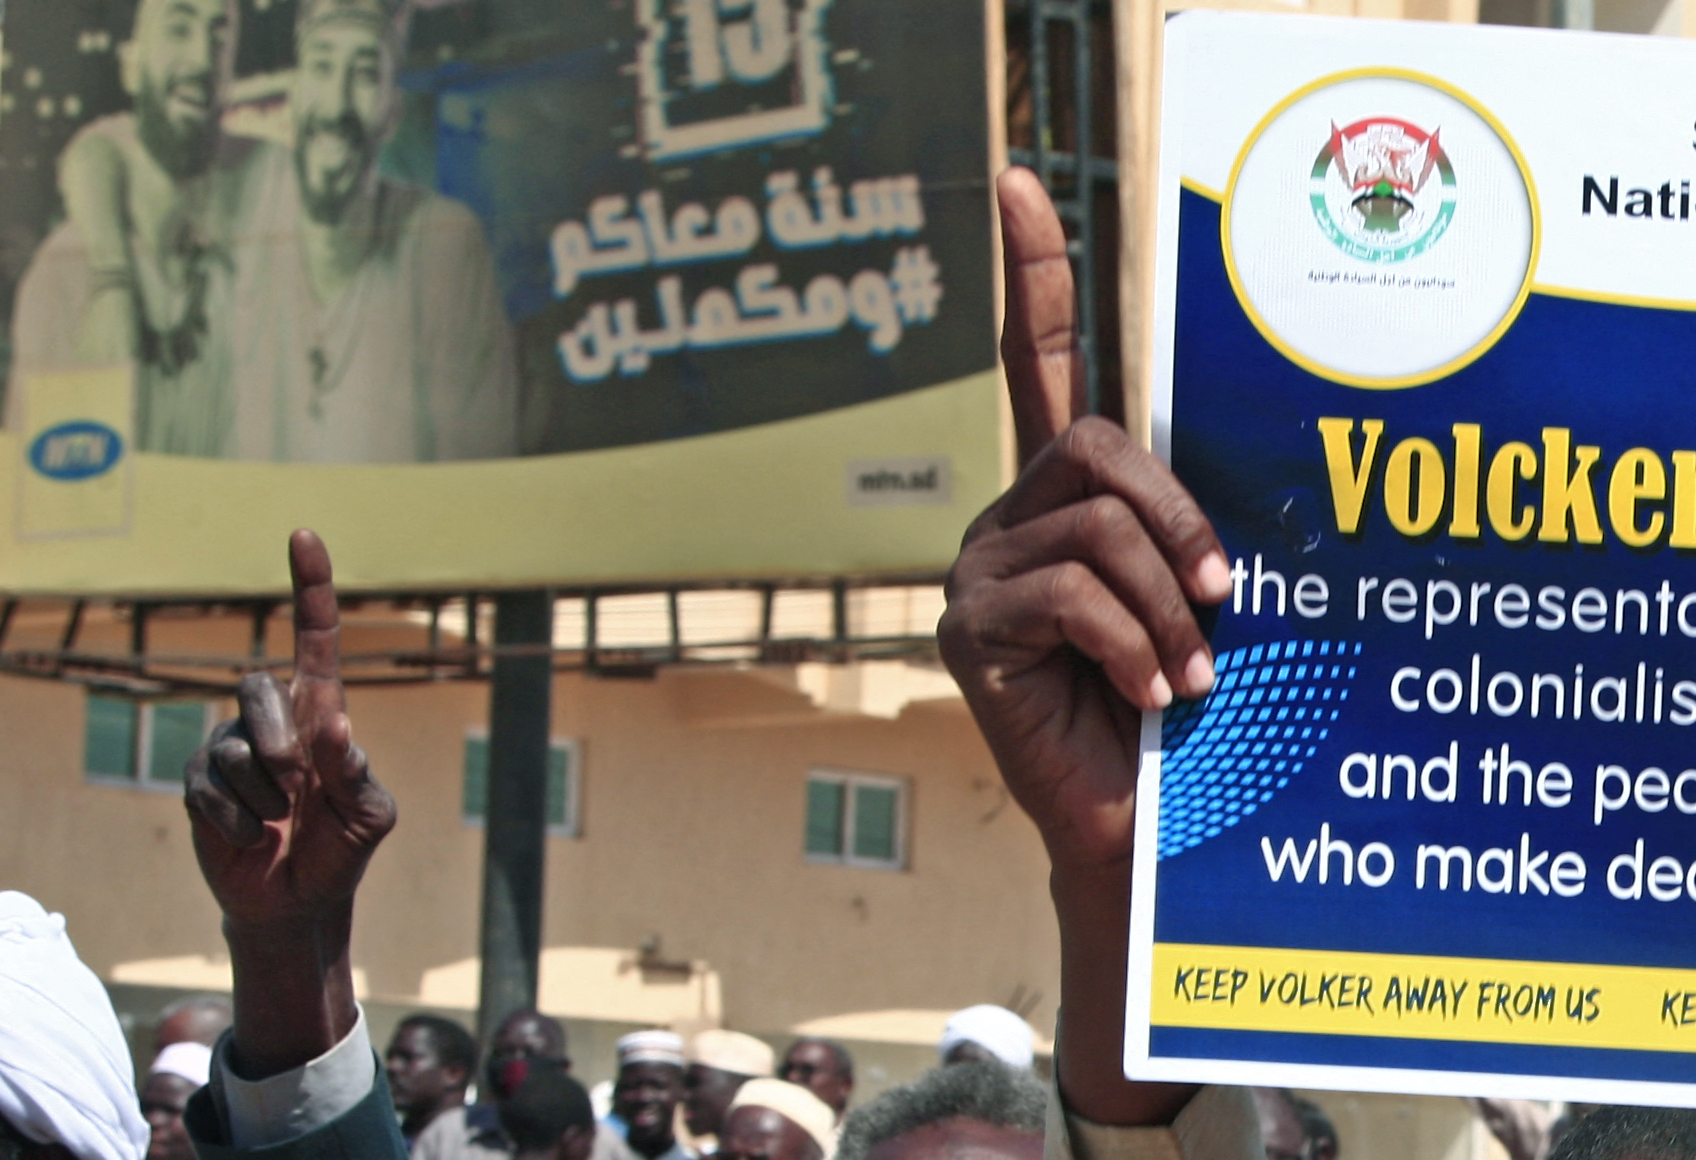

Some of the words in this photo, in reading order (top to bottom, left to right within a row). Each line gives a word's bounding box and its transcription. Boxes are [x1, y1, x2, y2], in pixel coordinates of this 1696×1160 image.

[550, 188, 760, 300] معاكم
[765, 166, 924, 251] سنة
[557, 245, 942, 383] #ومكملين
[1227, 552, 1331, 620] the
[1338, 739, 1460, 803] and
[1477, 742, 1575, 809] the
[1259, 821, 1396, 889] who
[1414, 831, 1588, 899] make
[1173, 967, 1248, 1005] KEEP
[1259, 971, 1373, 1013] VOLKER
[1382, 975, 1468, 1017] AWAY
[1476, 981, 1556, 1021] FROM
[1565, 987, 1601, 1023] US
